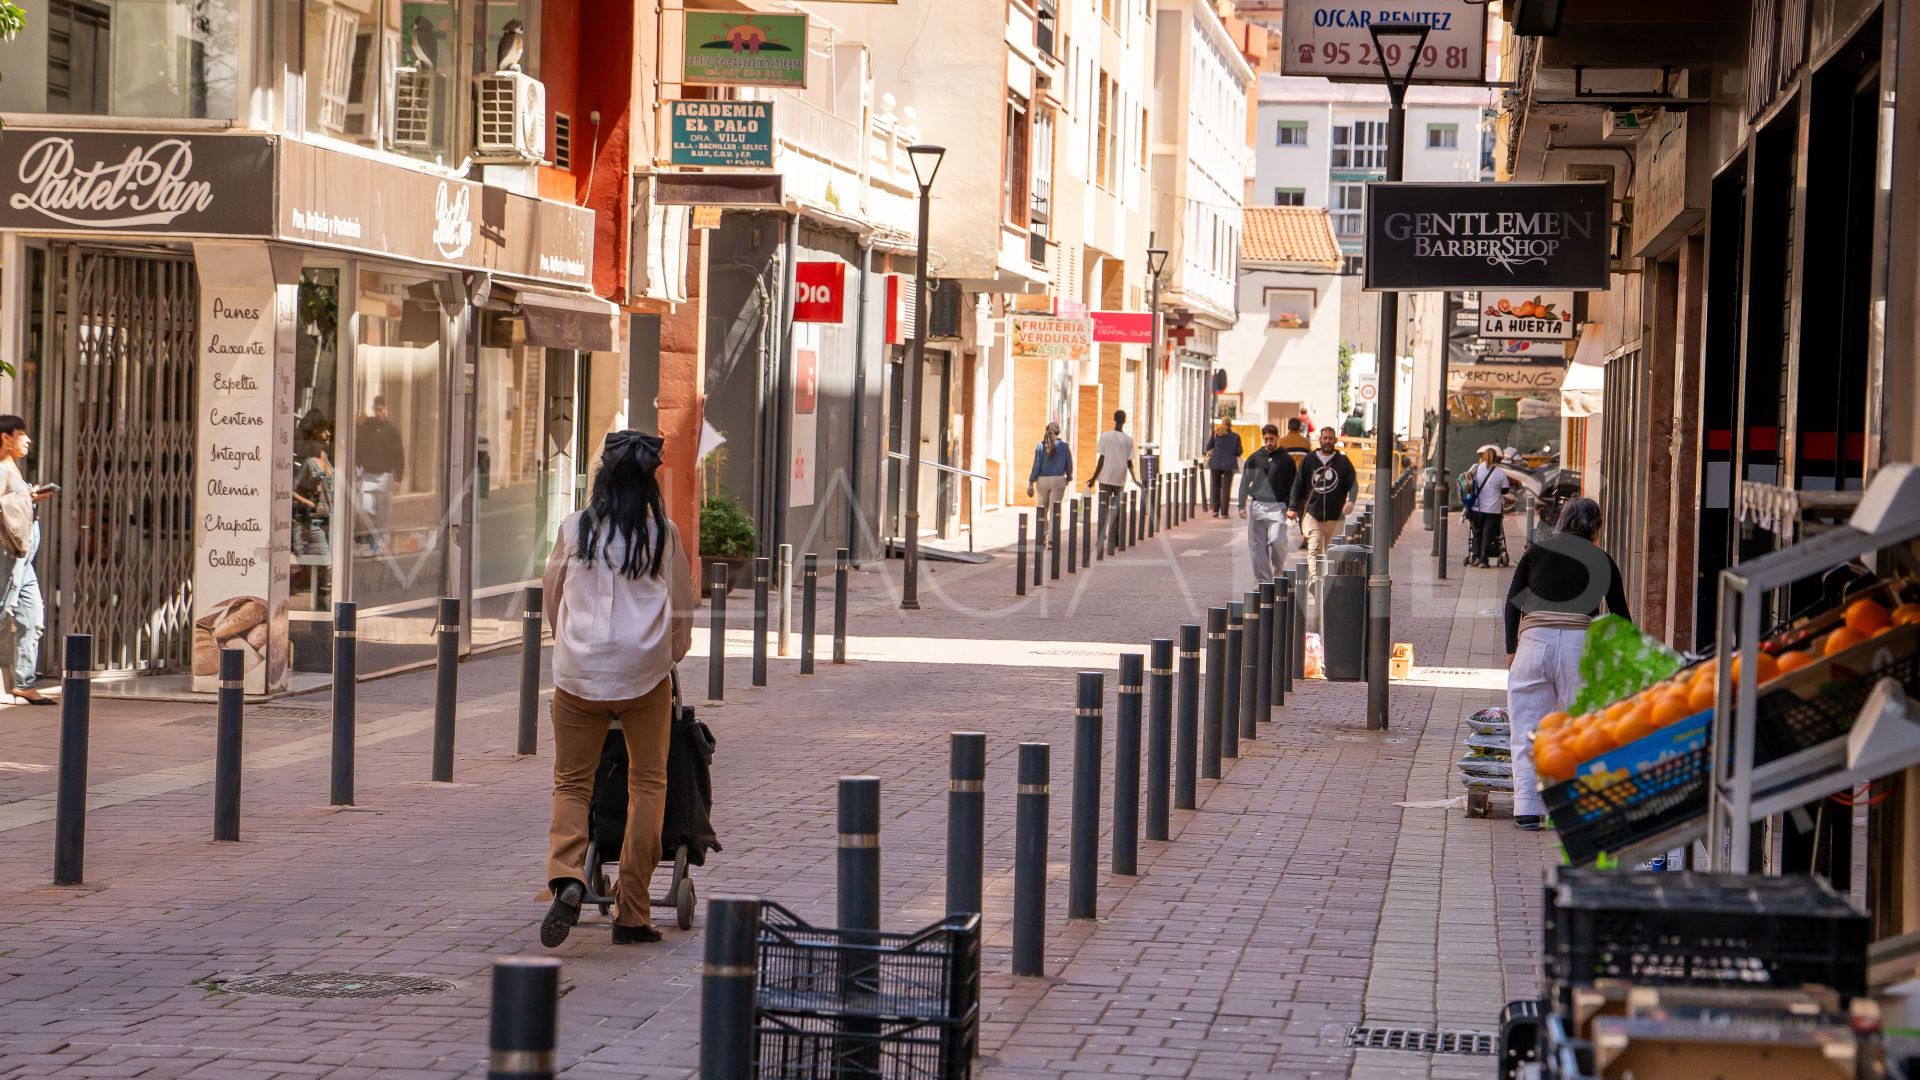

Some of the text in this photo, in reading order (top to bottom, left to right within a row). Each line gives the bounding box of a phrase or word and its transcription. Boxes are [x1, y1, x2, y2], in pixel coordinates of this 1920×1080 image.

[1314, 9, 1371, 27] OSCAR
[1323, 42, 1350, 64] 95
[1445, 46, 1468, 68] 81
[676, 103, 765, 118] ACADEMIA
[686, 118, 758, 133] EL PALO
[719, 133, 746, 143] VILU
[1384, 212, 1594, 240] GENTLEMEN
[213, 297, 260, 320] Panes
[1021, 320, 1084, 332] FRUTERIA
[1486, 320, 1503, 332] LA
[1509, 319, 1563, 334] HUERTA
[208, 334, 266, 355] Laxante
[1019, 332, 1087, 344] VERDURAS
[213, 373, 259, 395] Espelta
[210, 408, 264, 426] Centeno
[211, 444, 262, 470] Integral
[208, 479, 259, 496] Alemán
[204, 514, 262, 537] Chapata
[208, 549, 256, 577] Gallego
